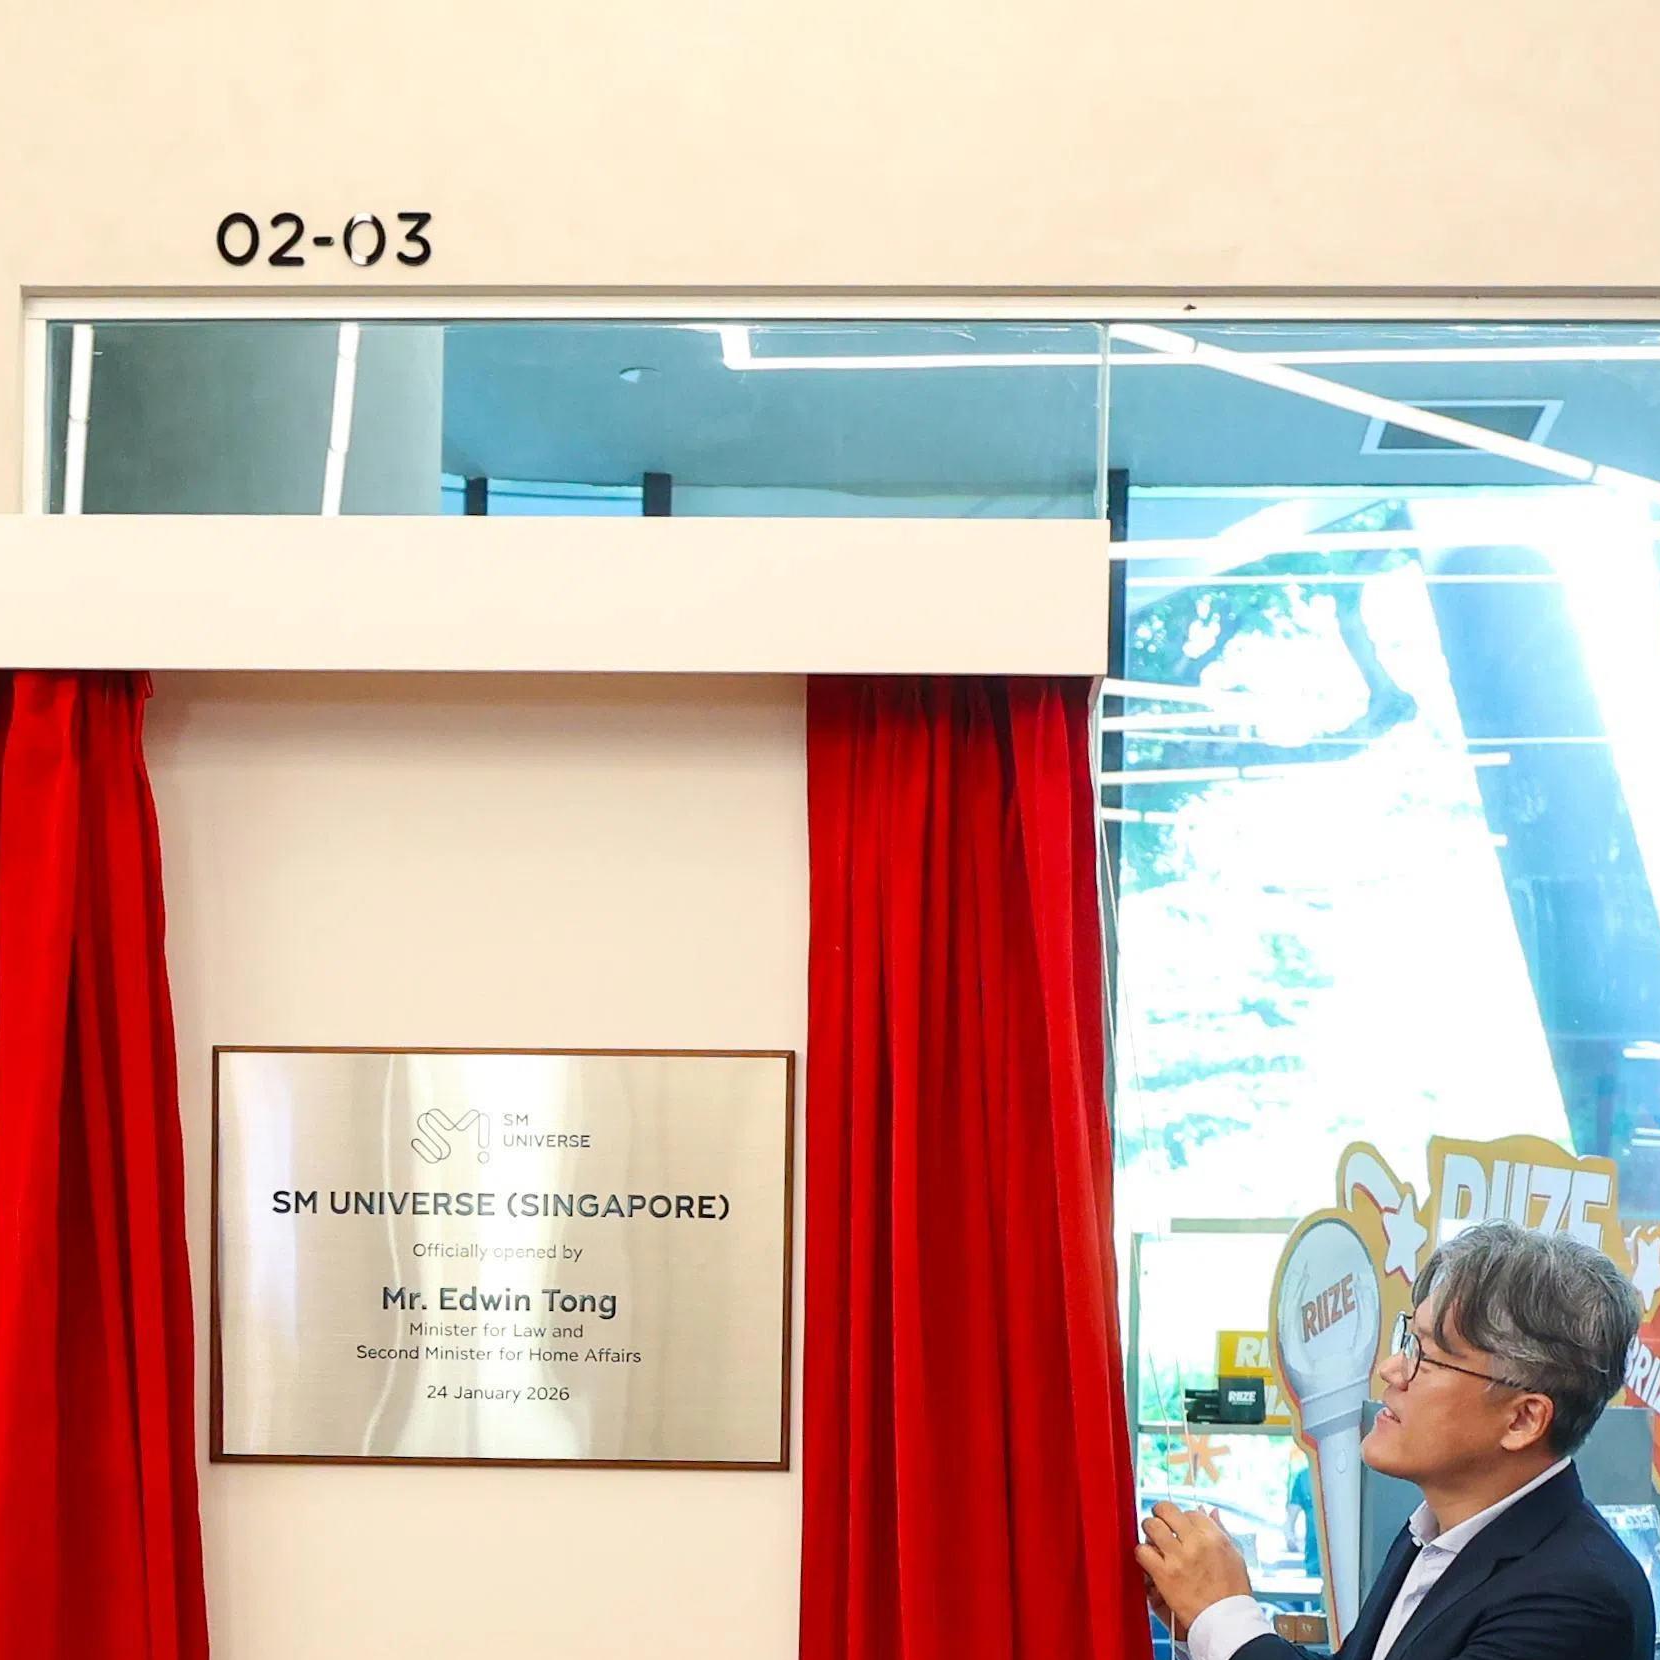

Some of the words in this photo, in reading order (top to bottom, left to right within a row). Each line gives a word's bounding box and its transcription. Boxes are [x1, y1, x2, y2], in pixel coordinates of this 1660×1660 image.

[216, 212, 432, 267] 02-03
[503, 1113, 529, 1127] SM
[503, 1134, 591, 1148] UNIVERSE
[272, 1190, 318, 1214] SM
[330, 1191, 495, 1217] UNIVERSE
[507, 1192, 730, 1221] (SINGAPORE)
[412, 1243, 488, 1261] Officially
[493, 1245, 557, 1261] opened
[562, 1245, 583, 1263] by
[382, 1286, 428, 1311] Mr.
[440, 1286, 531, 1312] Edwin
[541, 1289, 617, 1320] Tong
[1301, 1272, 1356, 1343] RIIZE
[409, 1322, 478, 1337] Minister
[483, 1323, 507, 1338] for
[513, 1323, 547, 1338] Law
[552, 1324, 584, 1339] and
[356, 1344, 419, 1360] Second
[425, 1346, 492, 1361] Minister
[499, 1347, 524, 1362] for
[529, 1348, 579, 1363] Home
[584, 1347, 642, 1364] Affairs
[426, 1385, 448, 1399] 24
[454, 1386, 522, 1404] January
[527, 1386, 570, 1401] 2026
